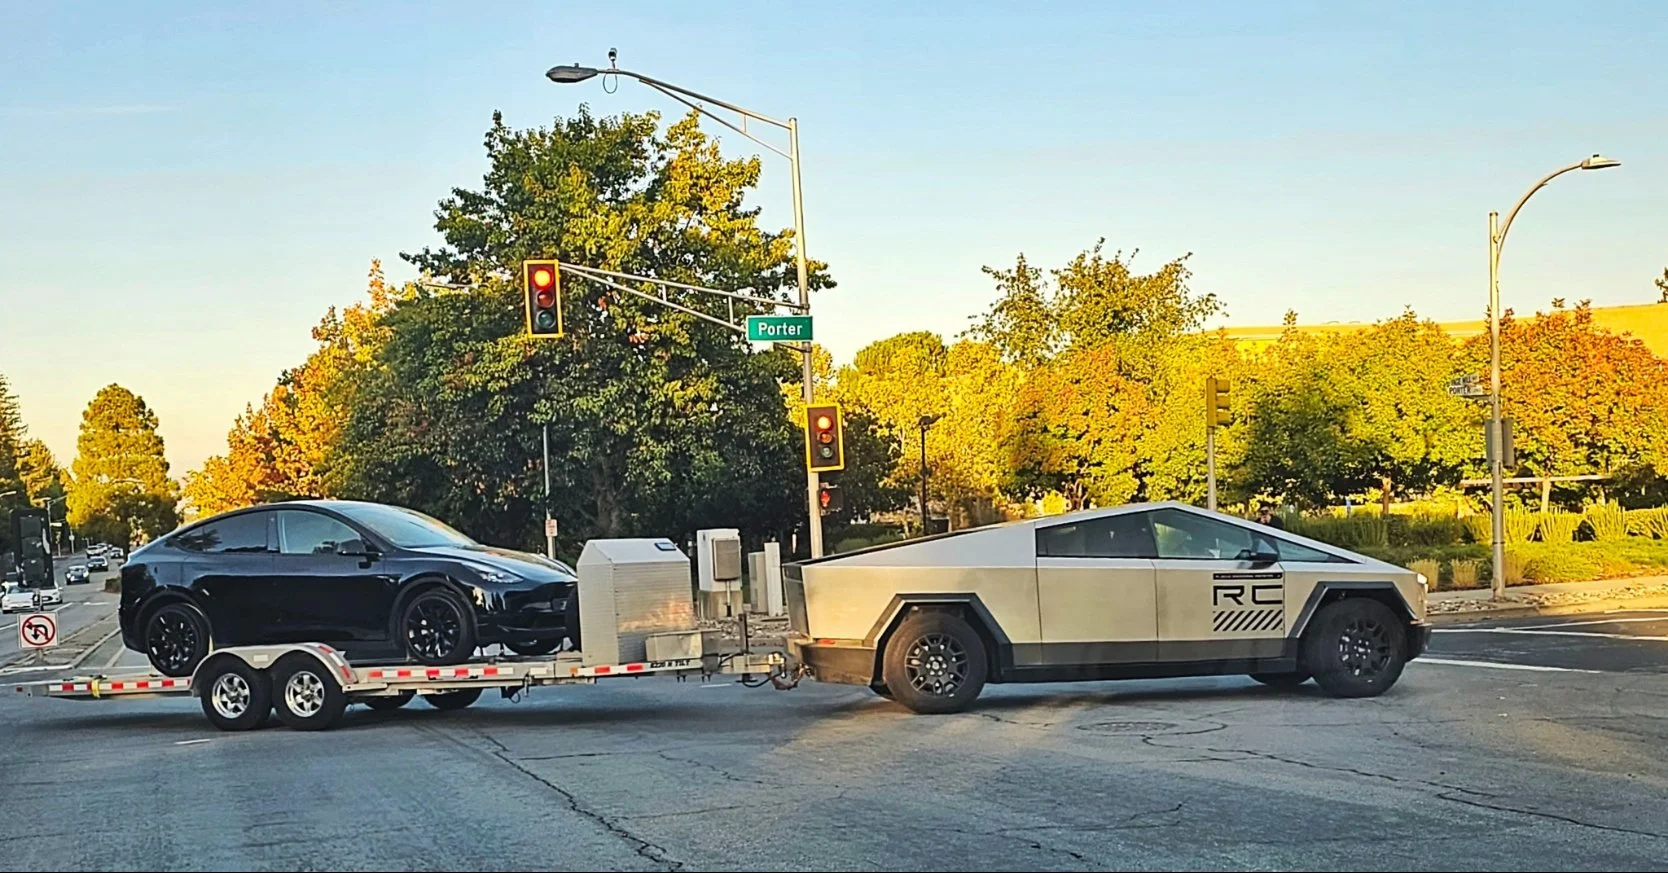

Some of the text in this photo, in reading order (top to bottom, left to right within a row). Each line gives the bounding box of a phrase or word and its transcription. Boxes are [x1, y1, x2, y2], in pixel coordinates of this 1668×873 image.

[758, 322, 803, 336] Porter
[1449, 386, 1471, 395] PORTER
[1213, 585, 1283, 606] RC
